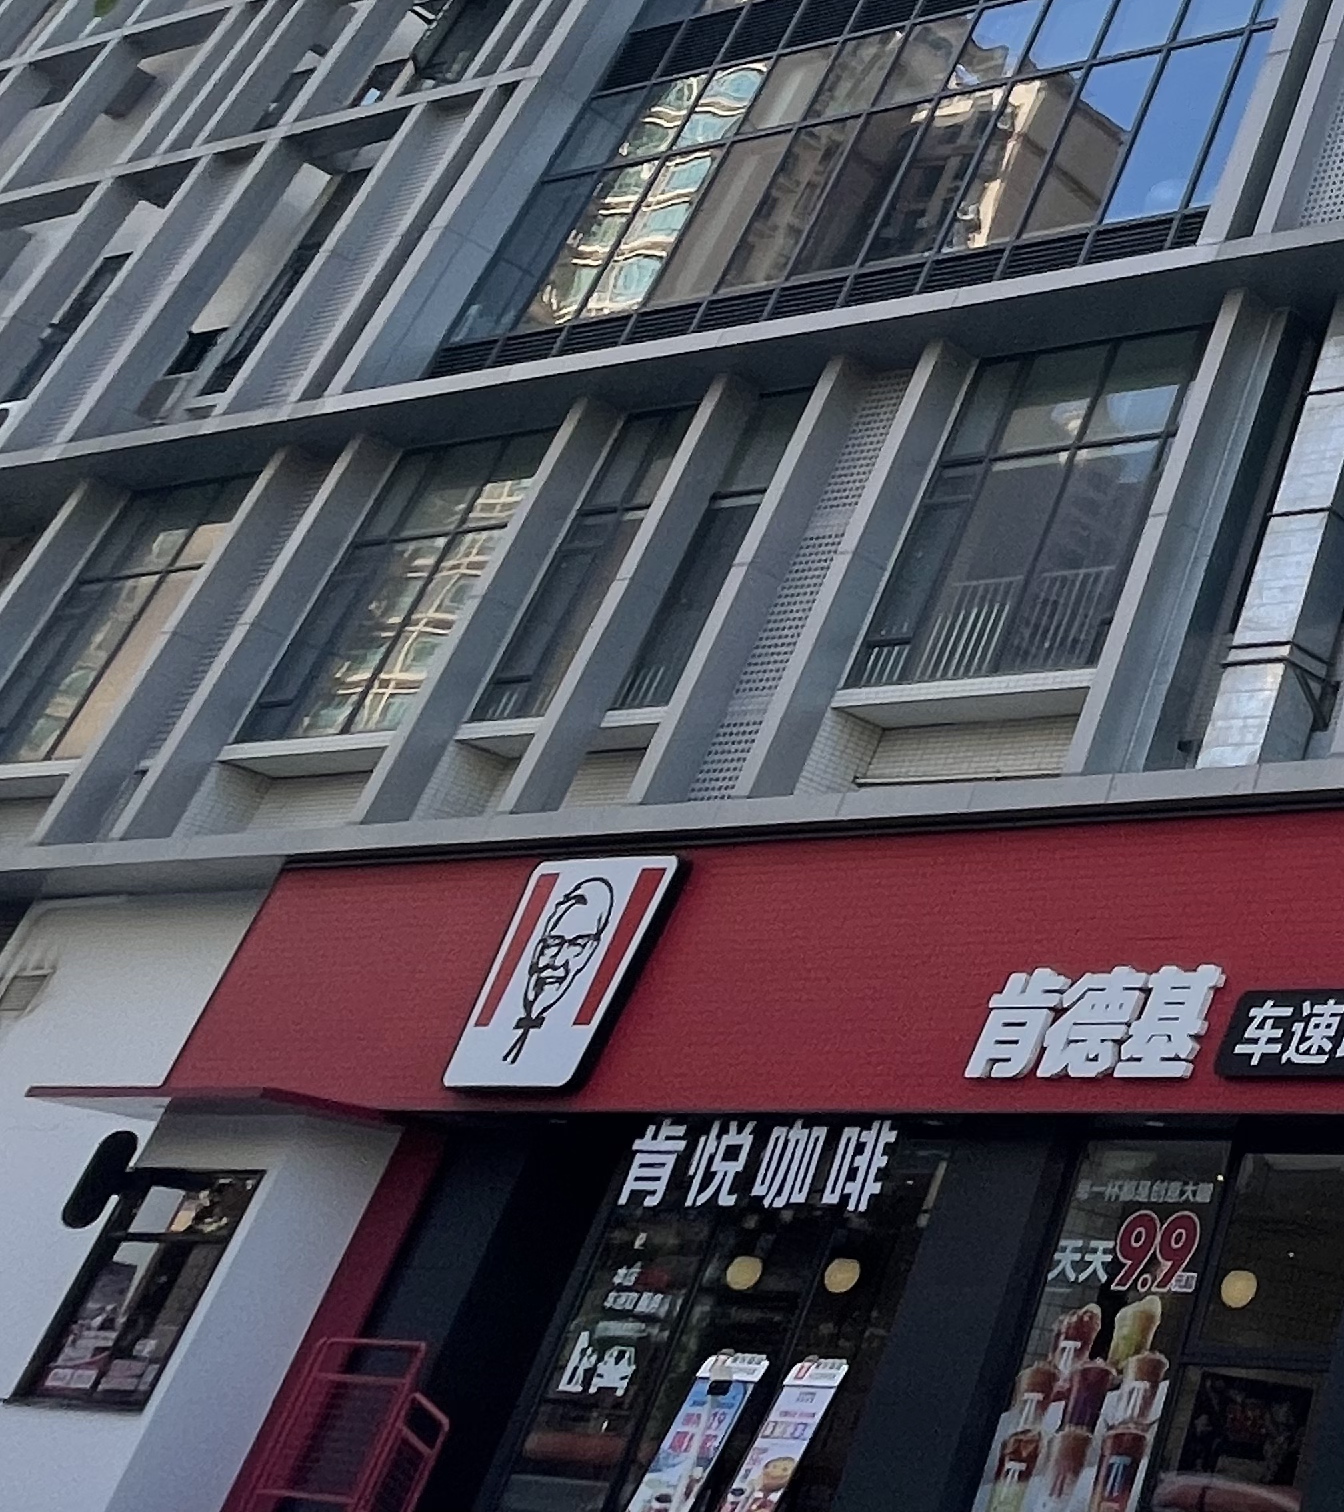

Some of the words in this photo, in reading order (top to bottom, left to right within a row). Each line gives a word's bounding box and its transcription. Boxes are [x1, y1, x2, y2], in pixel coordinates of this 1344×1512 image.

[963, 963, 1228, 1079] 肯德基
[616, 1118, 898, 1212] 肯悦咖啡
